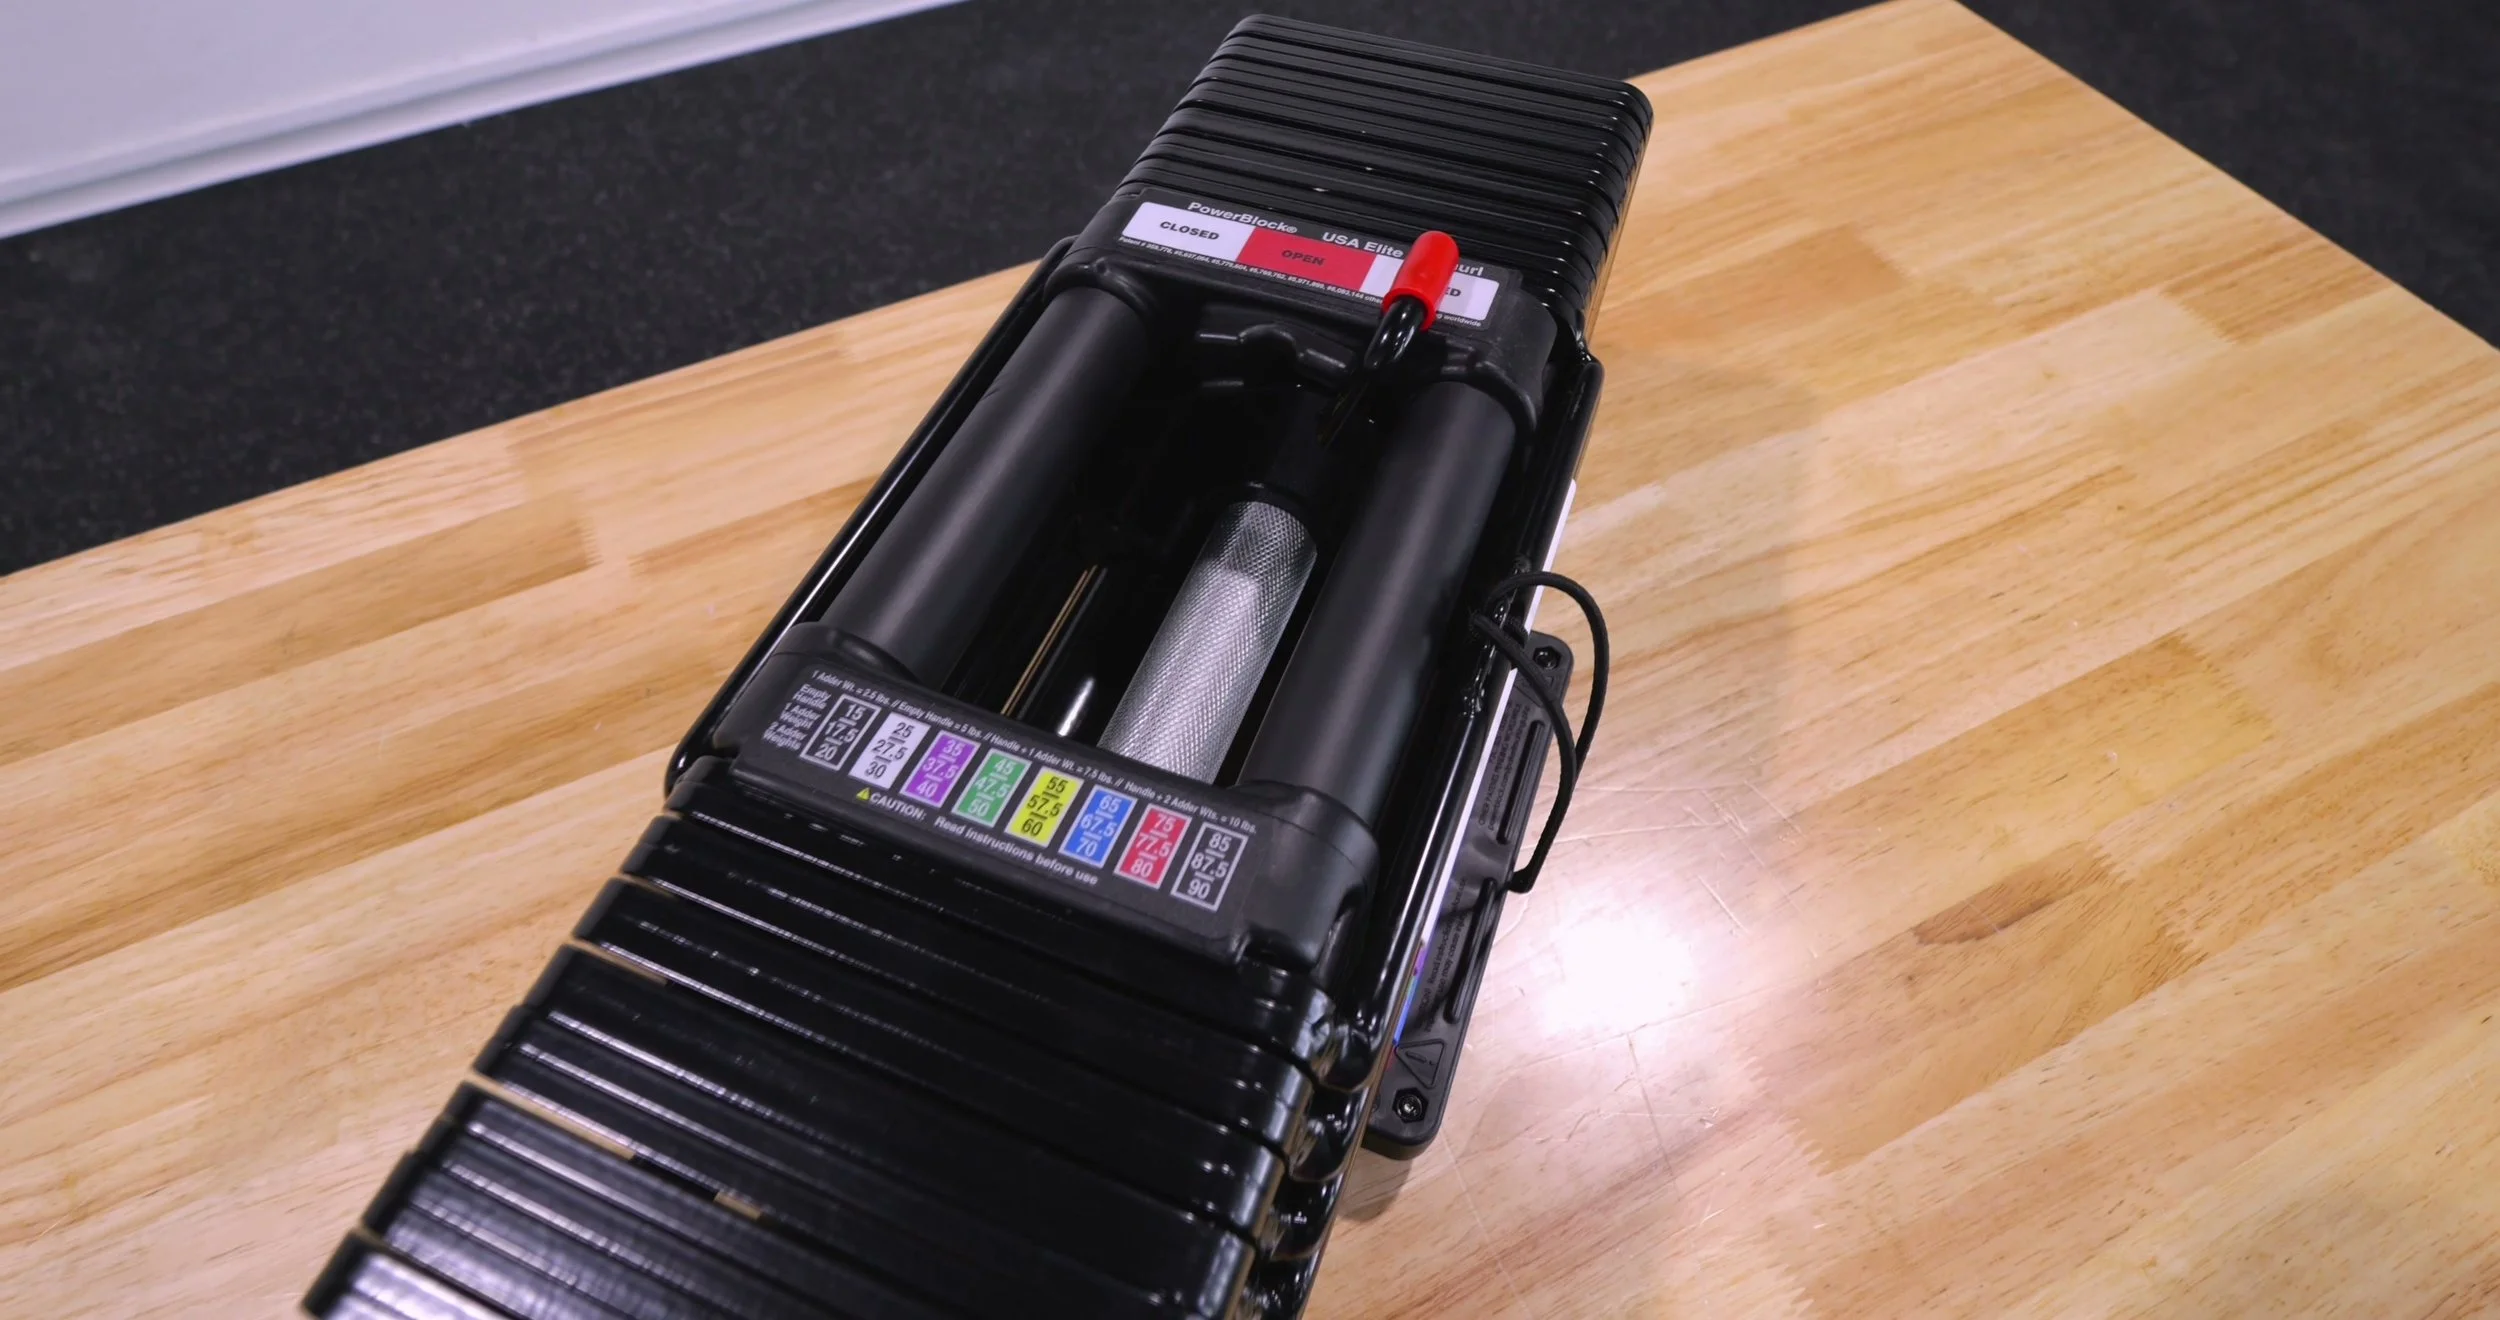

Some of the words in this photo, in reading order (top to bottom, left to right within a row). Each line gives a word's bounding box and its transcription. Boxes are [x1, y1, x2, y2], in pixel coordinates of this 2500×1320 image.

[1159, 220, 1220, 241] CLOSED
[1322, 231, 1360, 249] USA
[1364, 241, 1404, 258] Elite
[1281, 249, 1326, 267] OPEN
[1454, 263, 1484, 277] url
[1443, 313, 1482, 327] worldwide
[792, 691, 828, 710] Handle
[800, 683, 832, 702] Empty
[778, 709, 815, 730] Weight
[790, 703, 822, 721] Adder
[844, 704, 867, 722] 15
[762, 728, 803, 751] Weights
[768, 721, 779, 731] 2
[777, 723, 808, 741] Adder
[824, 720, 859, 743] 17.5
[891, 721, 915, 739] 25
[812, 670, 819, 678] 1
[817, 672, 843, 687] Adder
[841, 679, 856, 693] Wt.
[862, 688, 877, 701] 2.5
[874, 693, 891, 706] lbs.
[899, 700, 926, 718] Empty
[925, 711, 954, 729] Handle
[960, 723, 968, 733] 5
[966, 727, 983, 740] lbs.
[990, 734, 1021, 752] Handle
[1034, 750, 1061, 766] Adder
[1084, 766, 1098, 779] 7.5
[1098, 771, 1114, 785] lbs.
[1124, 782, 1156, 800] Handle
[1163, 793, 1172, 804] 2
[1171, 797, 1199, 815] Adder
[1199, 805, 1218, 820] Wts.
[1228, 815, 1242, 828] 10
[1240, 820, 1257, 835] lbs.
[814, 743, 838, 761] 20
[871, 739, 909, 761] 27.5
[942, 739, 966, 757] 35
[864, 761, 888, 780] 30
[922, 757, 959, 779] 37.5
[993, 758, 1017, 775] 45
[916, 781, 939, 799] 40
[974, 776, 1010, 798] 47.5
[1046, 776, 1068, 794] 55
[967, 798, 991, 816] 50
[1027, 794, 1063, 817] 57.5
[1099, 794, 1122, 813] 65
[1020, 817, 1044, 838] 60
[1079, 813, 1118, 838] 67.5
[1153, 813, 1177, 832] 75
[869, 791, 926, 822] CAUTION:
[933, 815, 965, 835] Read
[965, 826, 1033, 862] instructions
[1034, 853, 1075, 877] before
[1074, 870, 1099, 886] use
[1074, 837, 1098, 857] 70
[1135, 832, 1173, 858] 77.5
[1208, 832, 1233, 852] 85
[1130, 858, 1153, 879] 80
[1190, 852, 1230, 880] 87.5
[1187, 879, 1211, 900] 90
